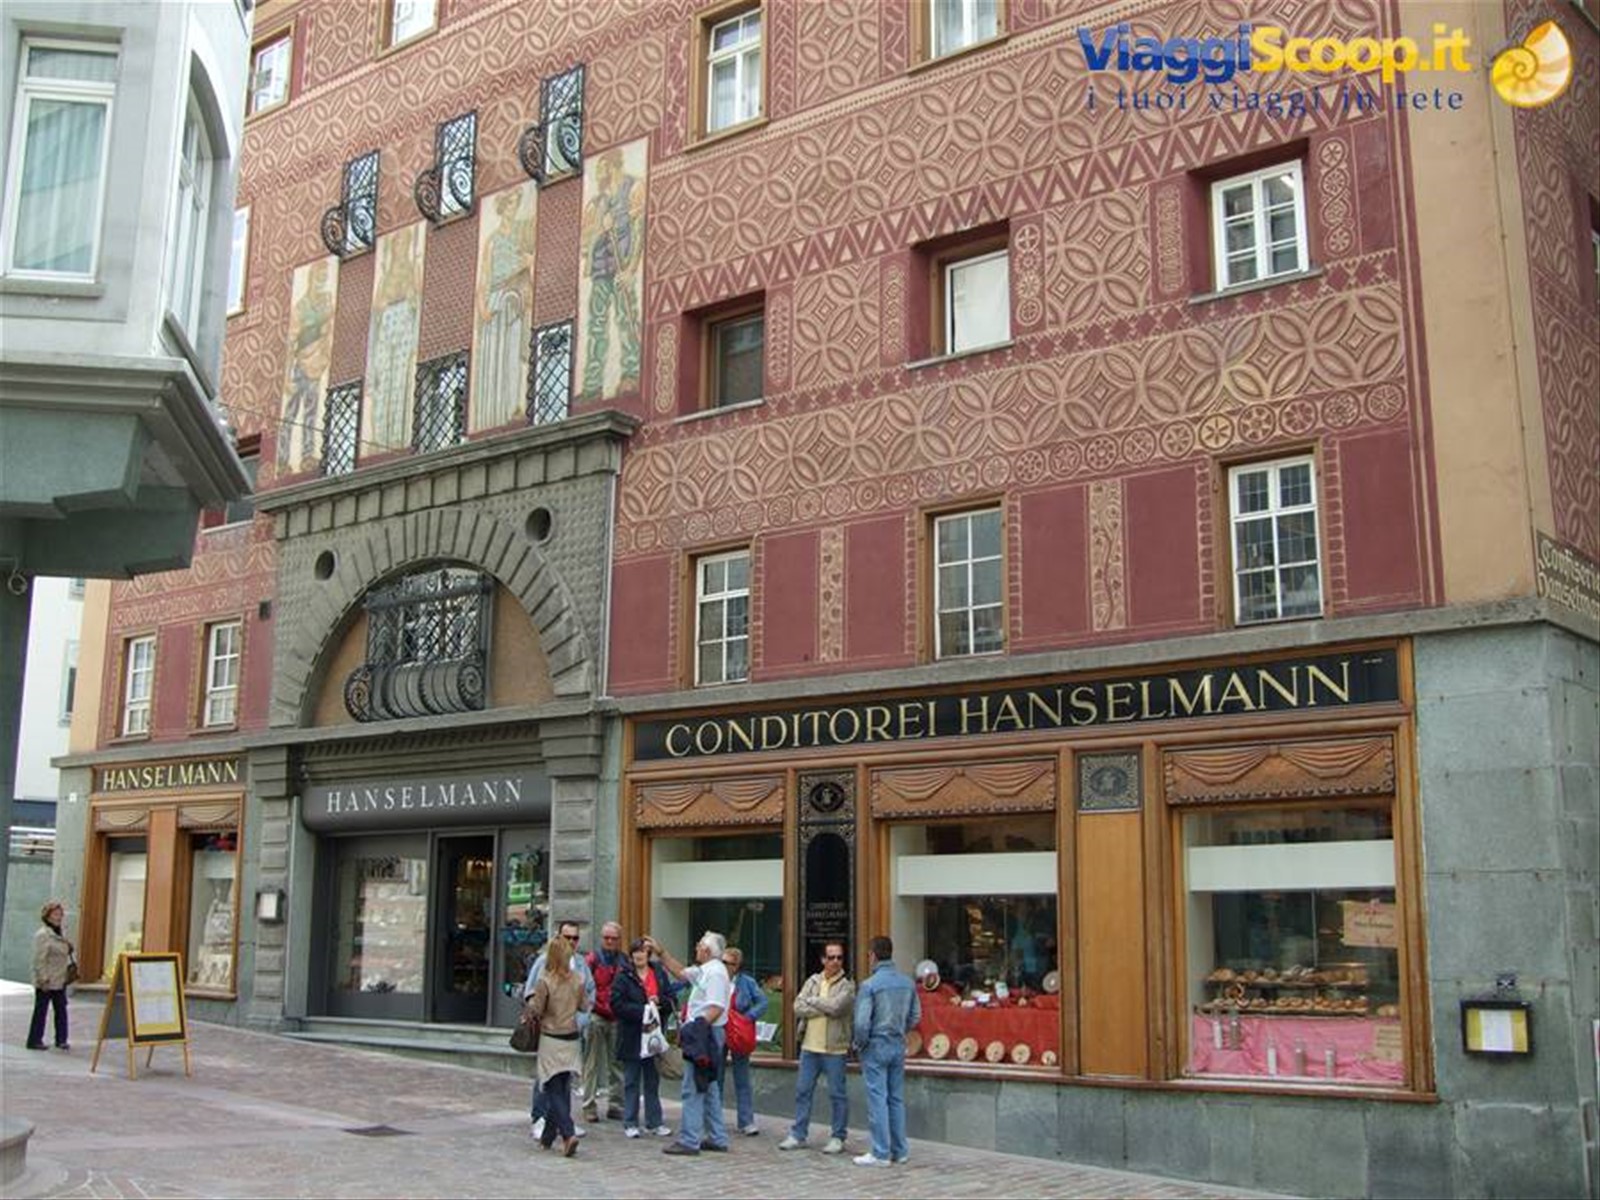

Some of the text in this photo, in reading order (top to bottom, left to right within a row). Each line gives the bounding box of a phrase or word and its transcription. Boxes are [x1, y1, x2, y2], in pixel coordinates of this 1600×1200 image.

[664, 660, 1352, 758] CONDITOREI HANSELMANN
[102, 760, 240, 791] HANSELMANN
[326, 778, 524, 813] HANSELMANN
